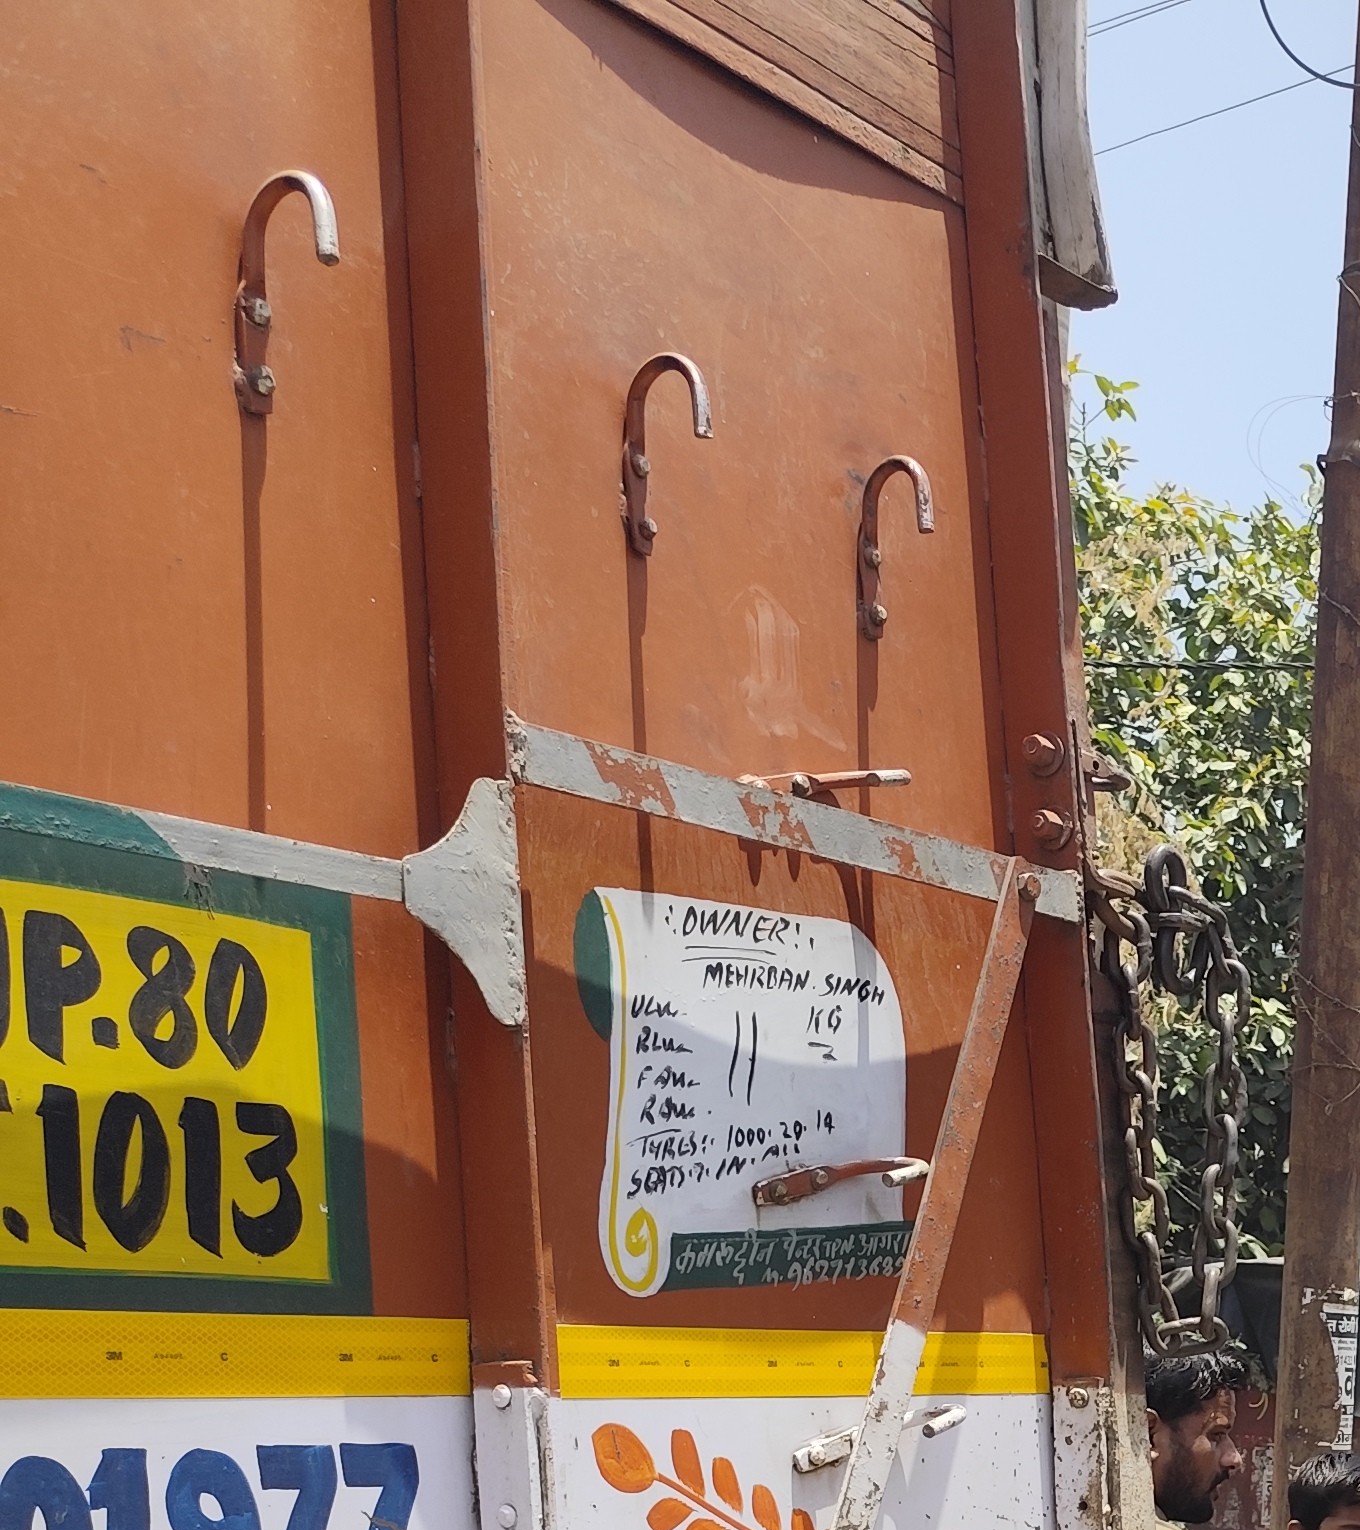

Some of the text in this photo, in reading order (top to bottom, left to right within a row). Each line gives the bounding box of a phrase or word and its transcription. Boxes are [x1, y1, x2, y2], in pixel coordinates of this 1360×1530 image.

[0, 907, 267, 1071] P.80
[819, 973, 885, 1005] SINGH
[0, 1079, 303, 1258] .1013
